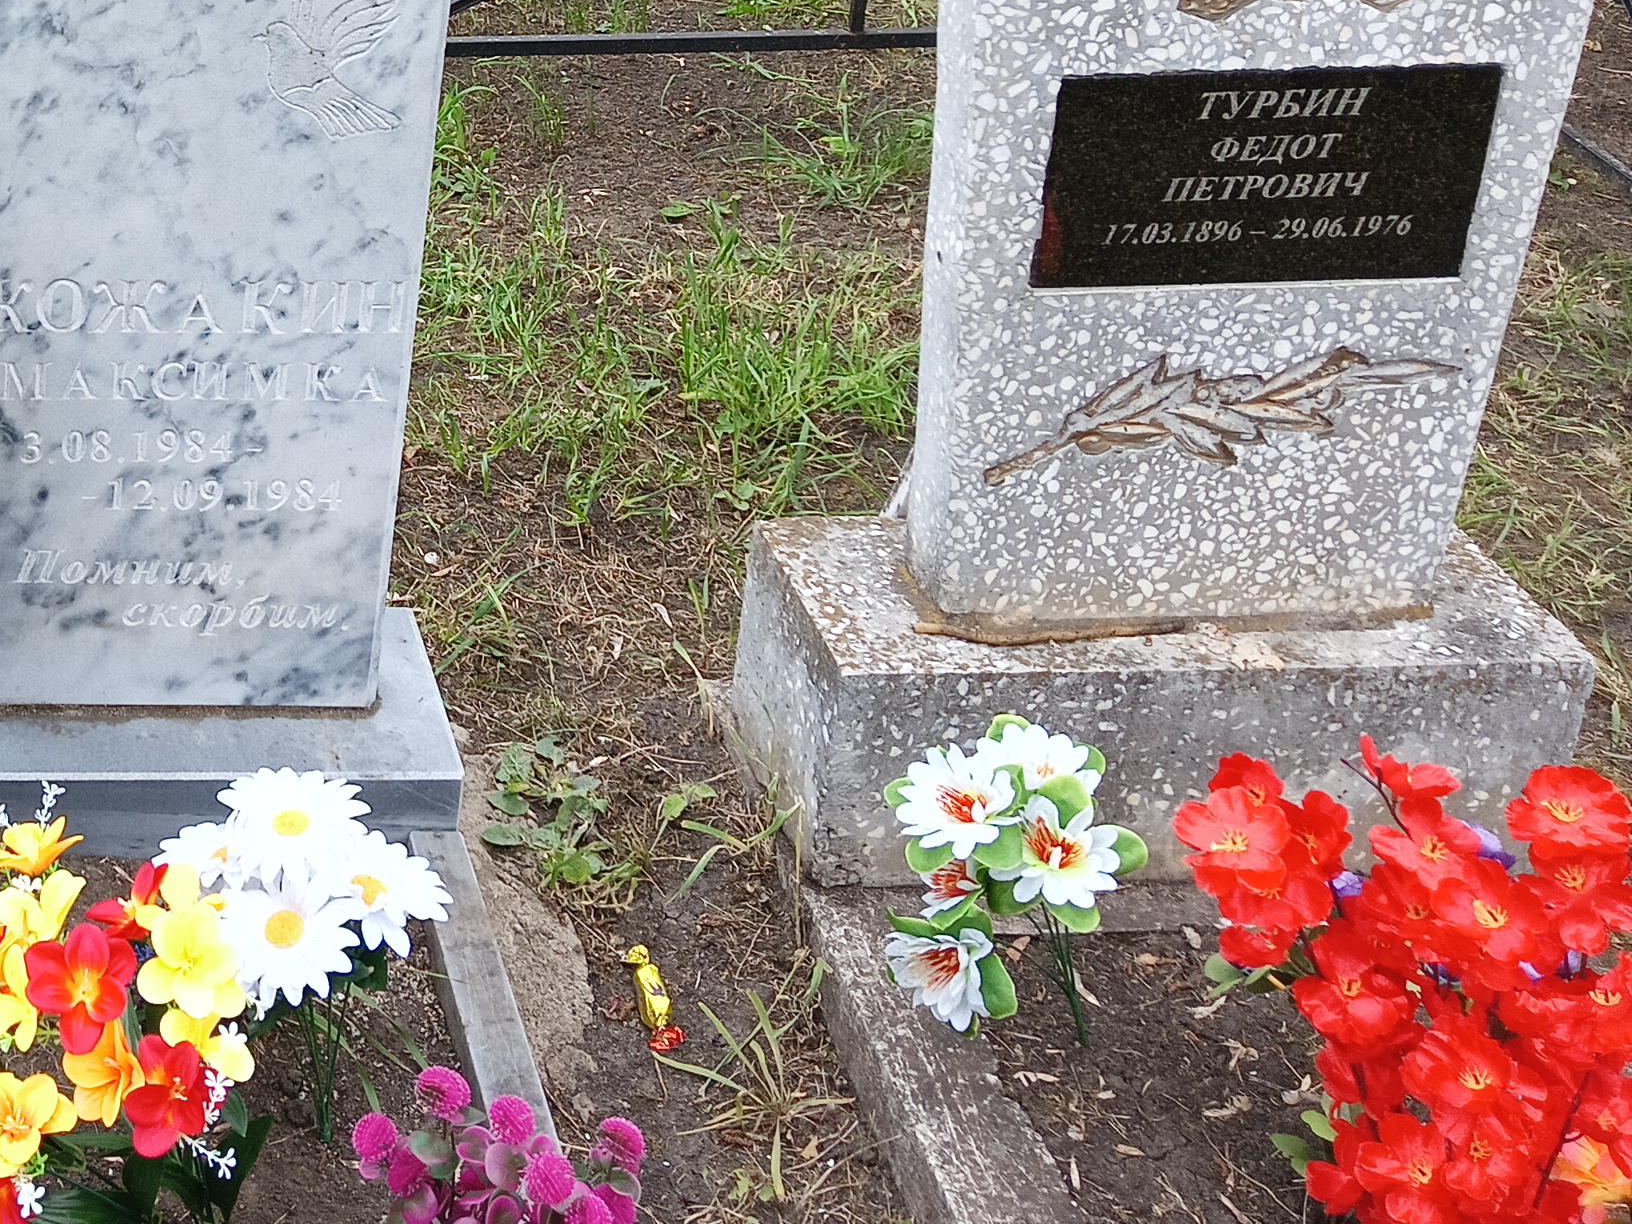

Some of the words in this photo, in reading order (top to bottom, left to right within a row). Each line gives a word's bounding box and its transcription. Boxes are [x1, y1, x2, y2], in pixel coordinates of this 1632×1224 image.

[1196, 86, 1372, 122] ТУРБИН
[1210, 133, 1343, 167] ФЕДОТ
[1161, 171, 1371, 203] ПЕТРОВИЧ
[1101, 219, 1243, 246] 17.03.1896
[1272, 213, 1414, 241] 29.06.1976
[12, 548, 249, 589] Помним,
[121, 593, 351, 637] скорбим.
